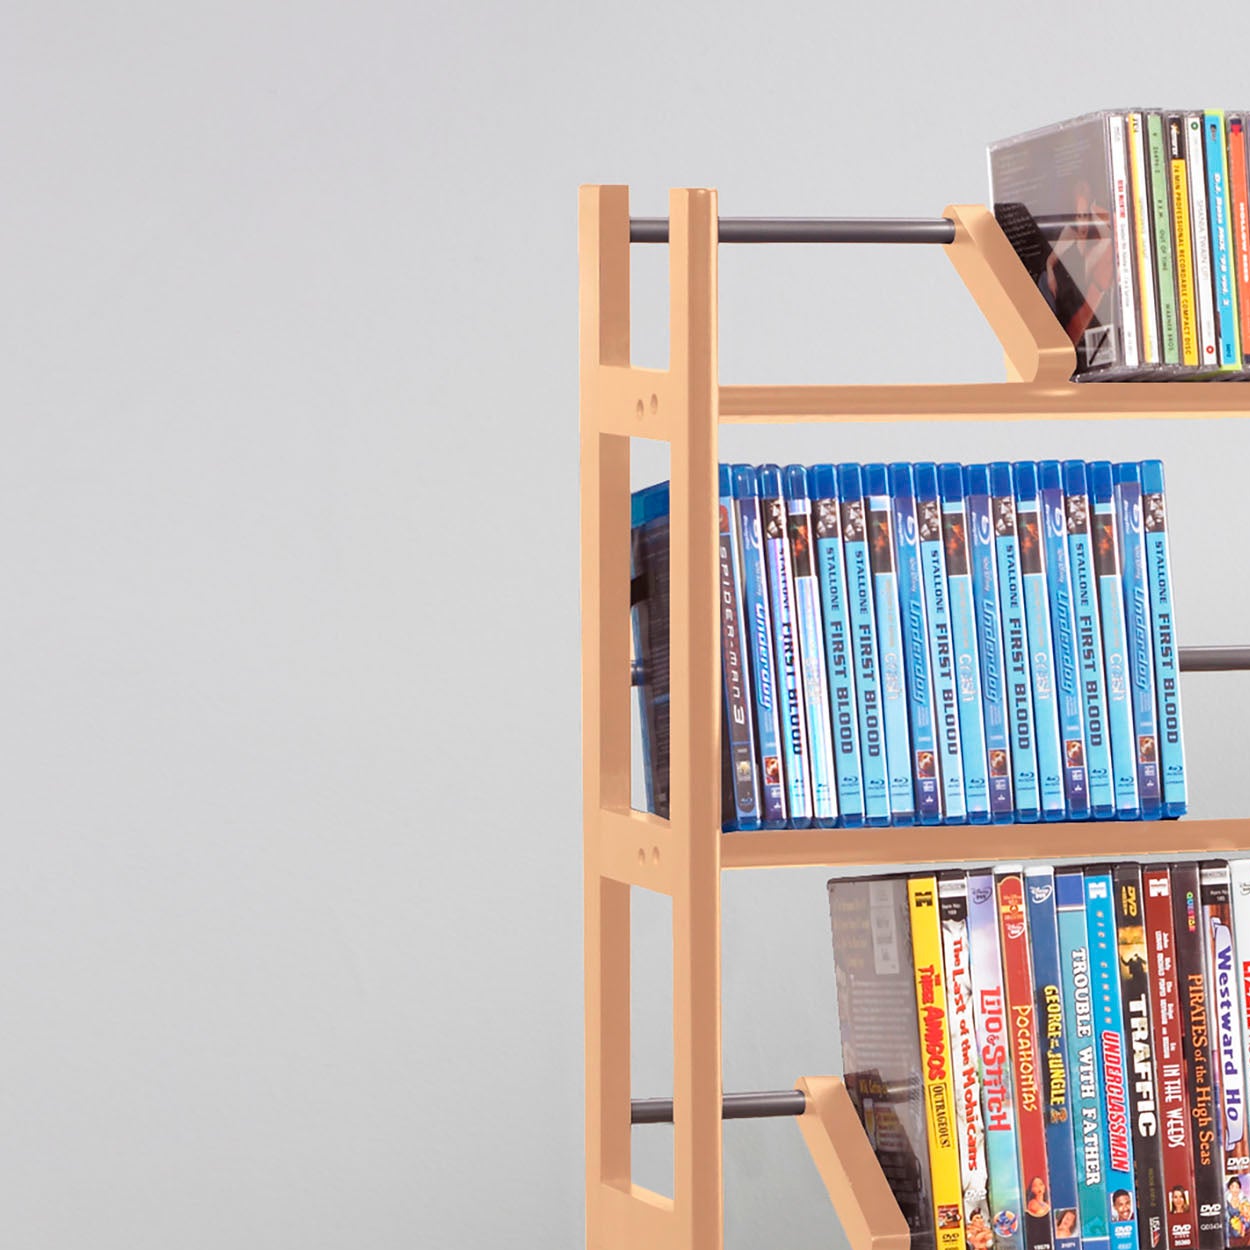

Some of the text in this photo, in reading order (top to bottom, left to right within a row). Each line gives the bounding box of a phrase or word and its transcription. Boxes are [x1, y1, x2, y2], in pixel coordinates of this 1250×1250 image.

[1161, 246, 1167, 254] OF
[1175, 192, 1184, 247] PROFESSIONAL
[1179, 250, 1187, 297] RECORDABLE
[1182, 300, 1190, 336] COMPACT
[826, 547, 853, 754] STALLONE FIRST BLOOD
[931, 550, 958, 755] STALLONE FIRST BLOOD
[983, 600, 1000, 702] Underdog
[1056, 591, 1076, 695] Underdog
[1076, 543, 1102, 747] STALLONE FIRST BLOOD
[1133, 586, 1150, 692] Underdog
[1155, 541, 1178, 744] STALLONE FIRST BLOOD
[733, 704, 744, 725] 3
[921, 1005, 945, 1080] AMIGOS
[951, 939, 979, 1171] The Last of the Mohicans
[1012, 1005, 1038, 1112] POCAHONTAS
[1044, 985, 1062, 1039] GEORGE
[1217, 945, 1240, 1122] Westward Ho
[1047, 1050, 1066, 1106] JUNGLE
[1071, 948, 1101, 1185] TROUBLE WITH FATHER
[1101, 1030, 1129, 1173] UNDERCLASSMAN
[1127, 993, 1156, 1137] TRAFFIC
[1163, 1064, 1180, 1078] IN
[1164, 1080, 1181, 1102] THE
[1187, 974, 1212, 1165] PIRATES of the High Seas
[931, 1086, 950, 1148] OUTRAGEOUS!
[1166, 1108, 1185, 1148] WEEDS
